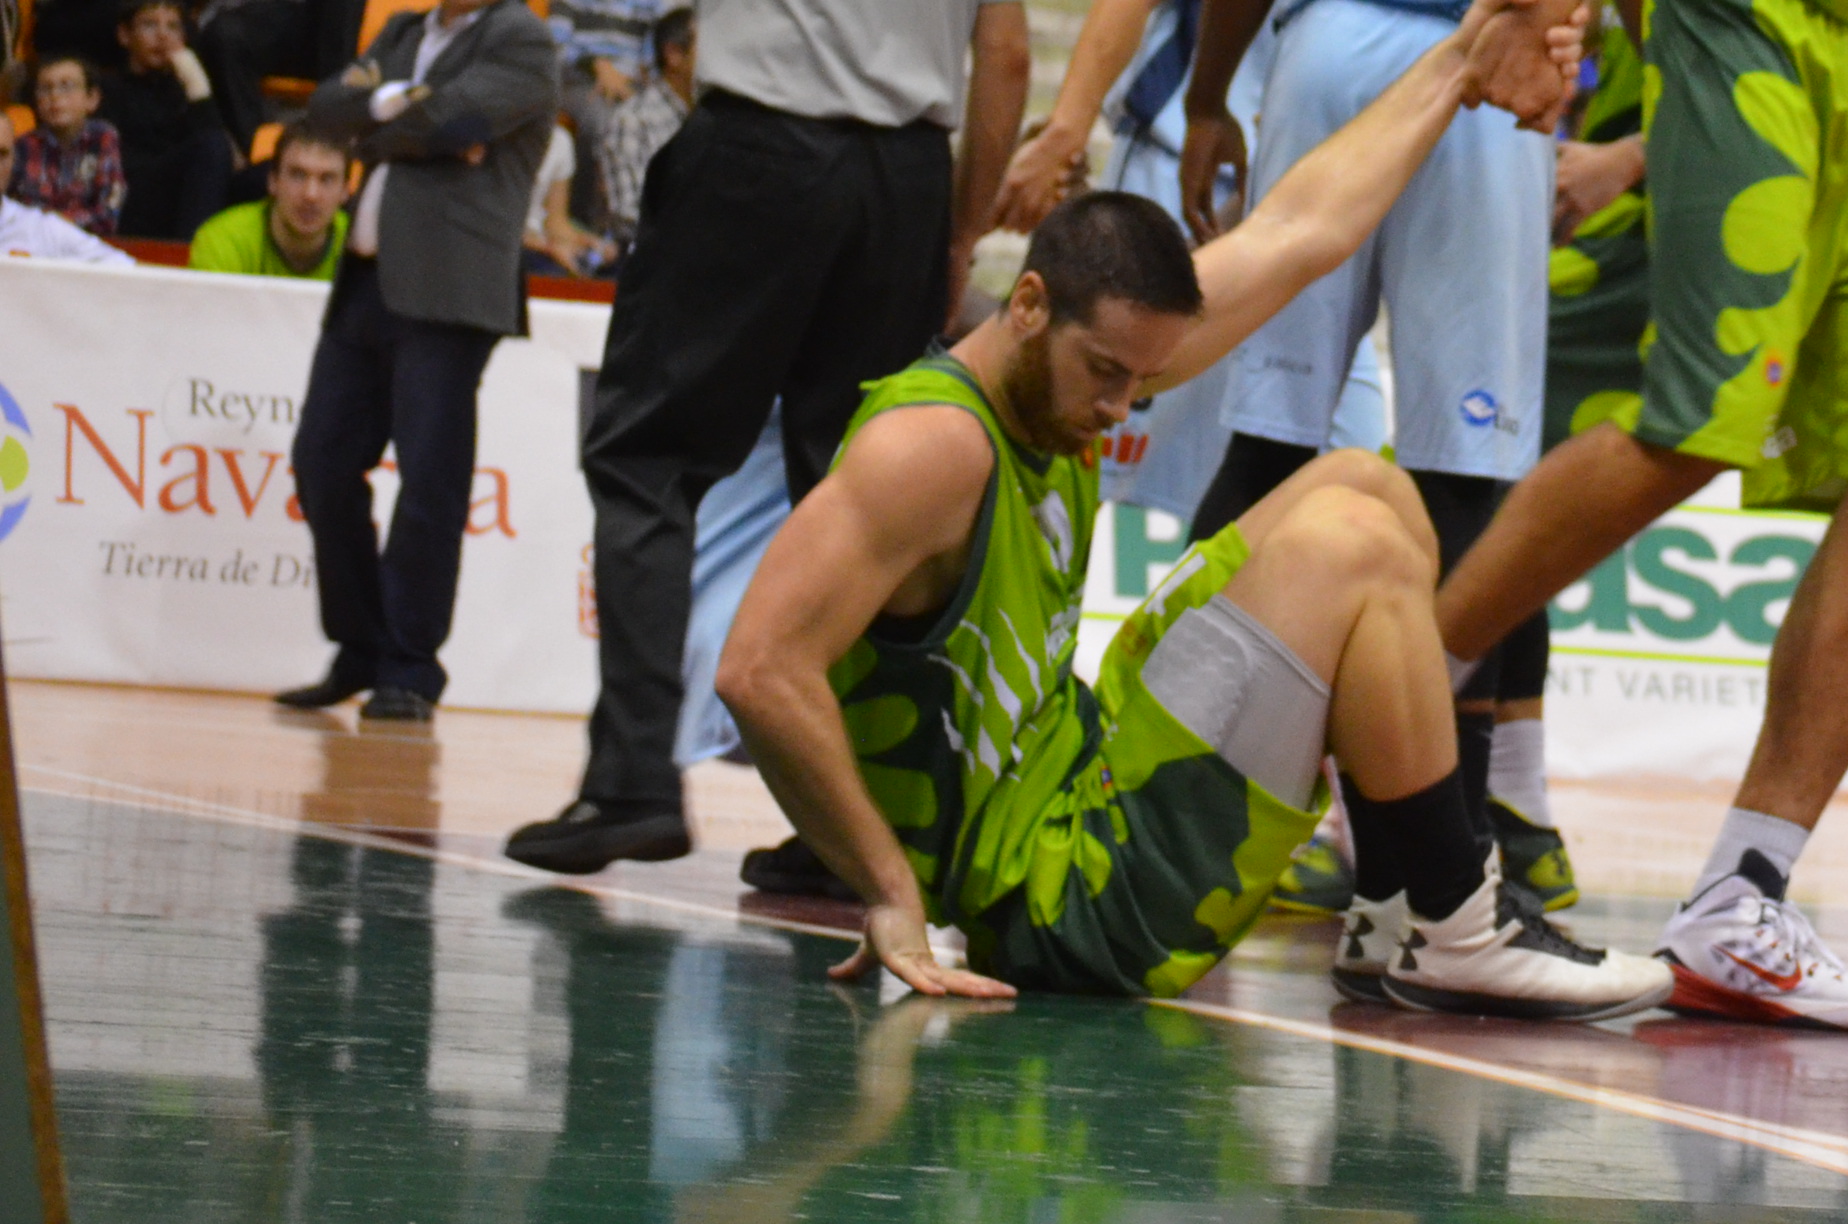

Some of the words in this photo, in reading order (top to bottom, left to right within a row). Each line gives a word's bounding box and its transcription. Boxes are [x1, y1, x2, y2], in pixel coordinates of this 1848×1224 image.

[189, 378, 298, 434] Reyn
[53, 402, 518, 539] Nava
[101, 540, 212, 582] Tierra
[219, 548, 258, 587] de
[1616, 672, 1764, 708] VARIET
